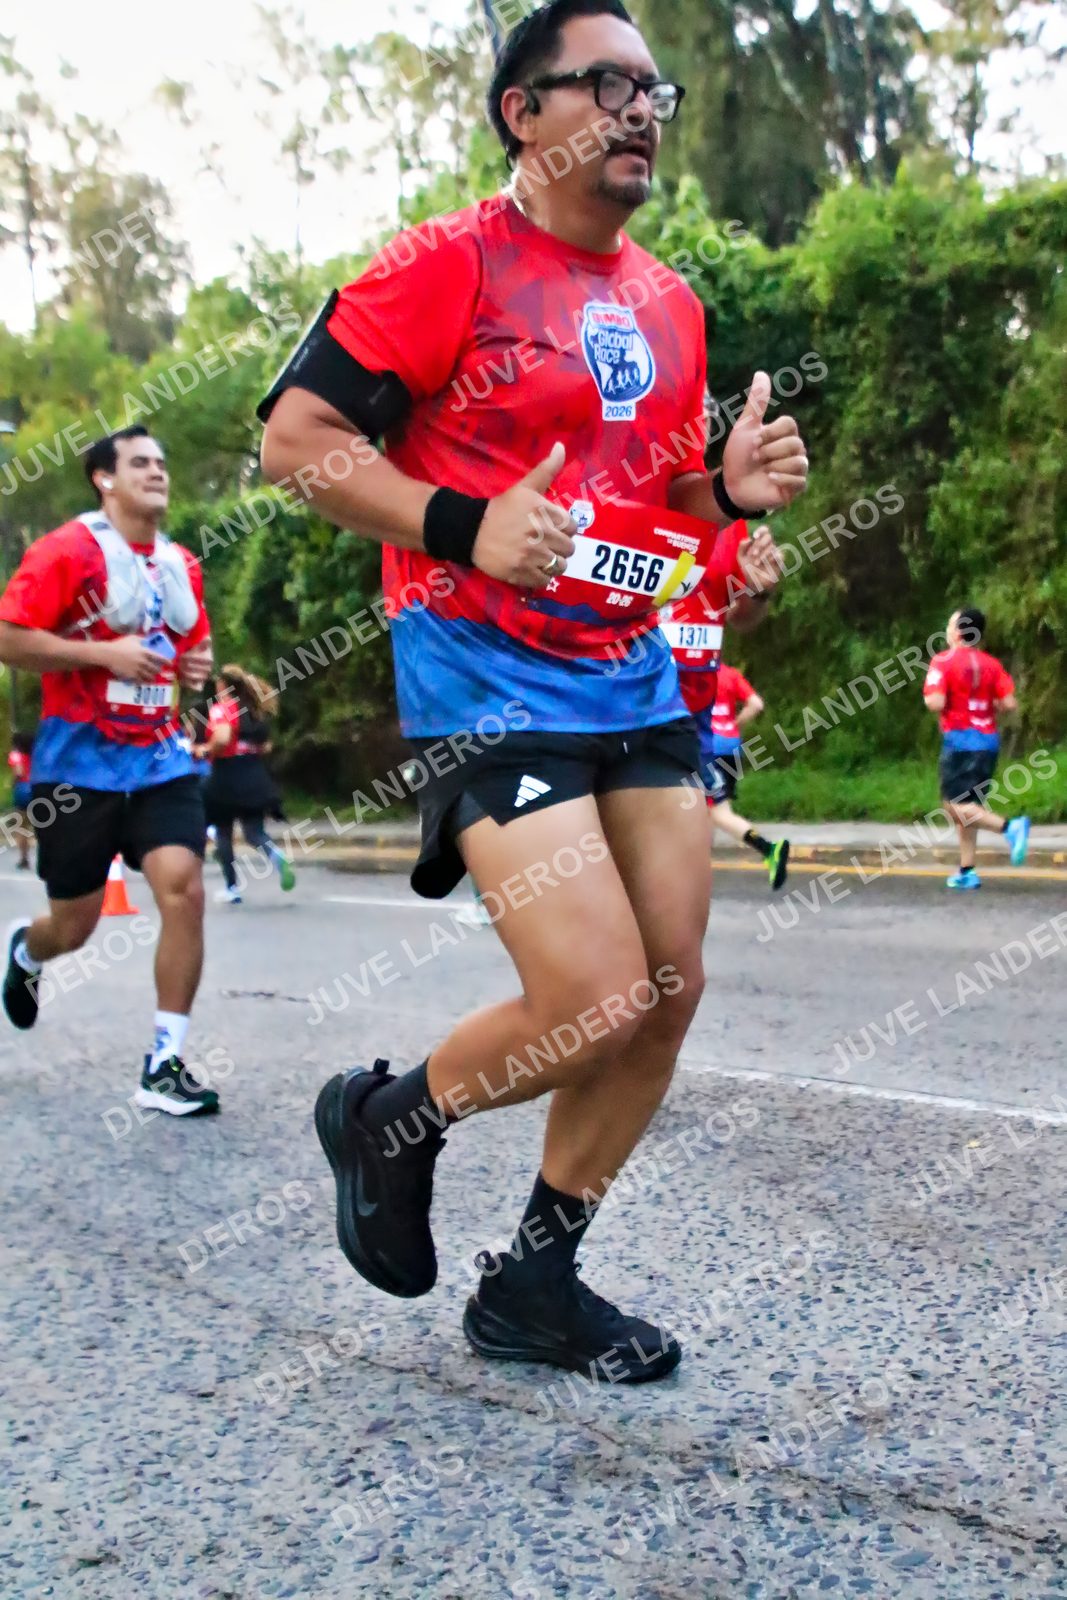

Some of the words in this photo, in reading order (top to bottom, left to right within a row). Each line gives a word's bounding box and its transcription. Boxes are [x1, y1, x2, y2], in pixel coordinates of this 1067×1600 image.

[598, 331, 633, 351] Global
[605, 405, 632, 418] 2026
[591, 544, 664, 593] 2656
